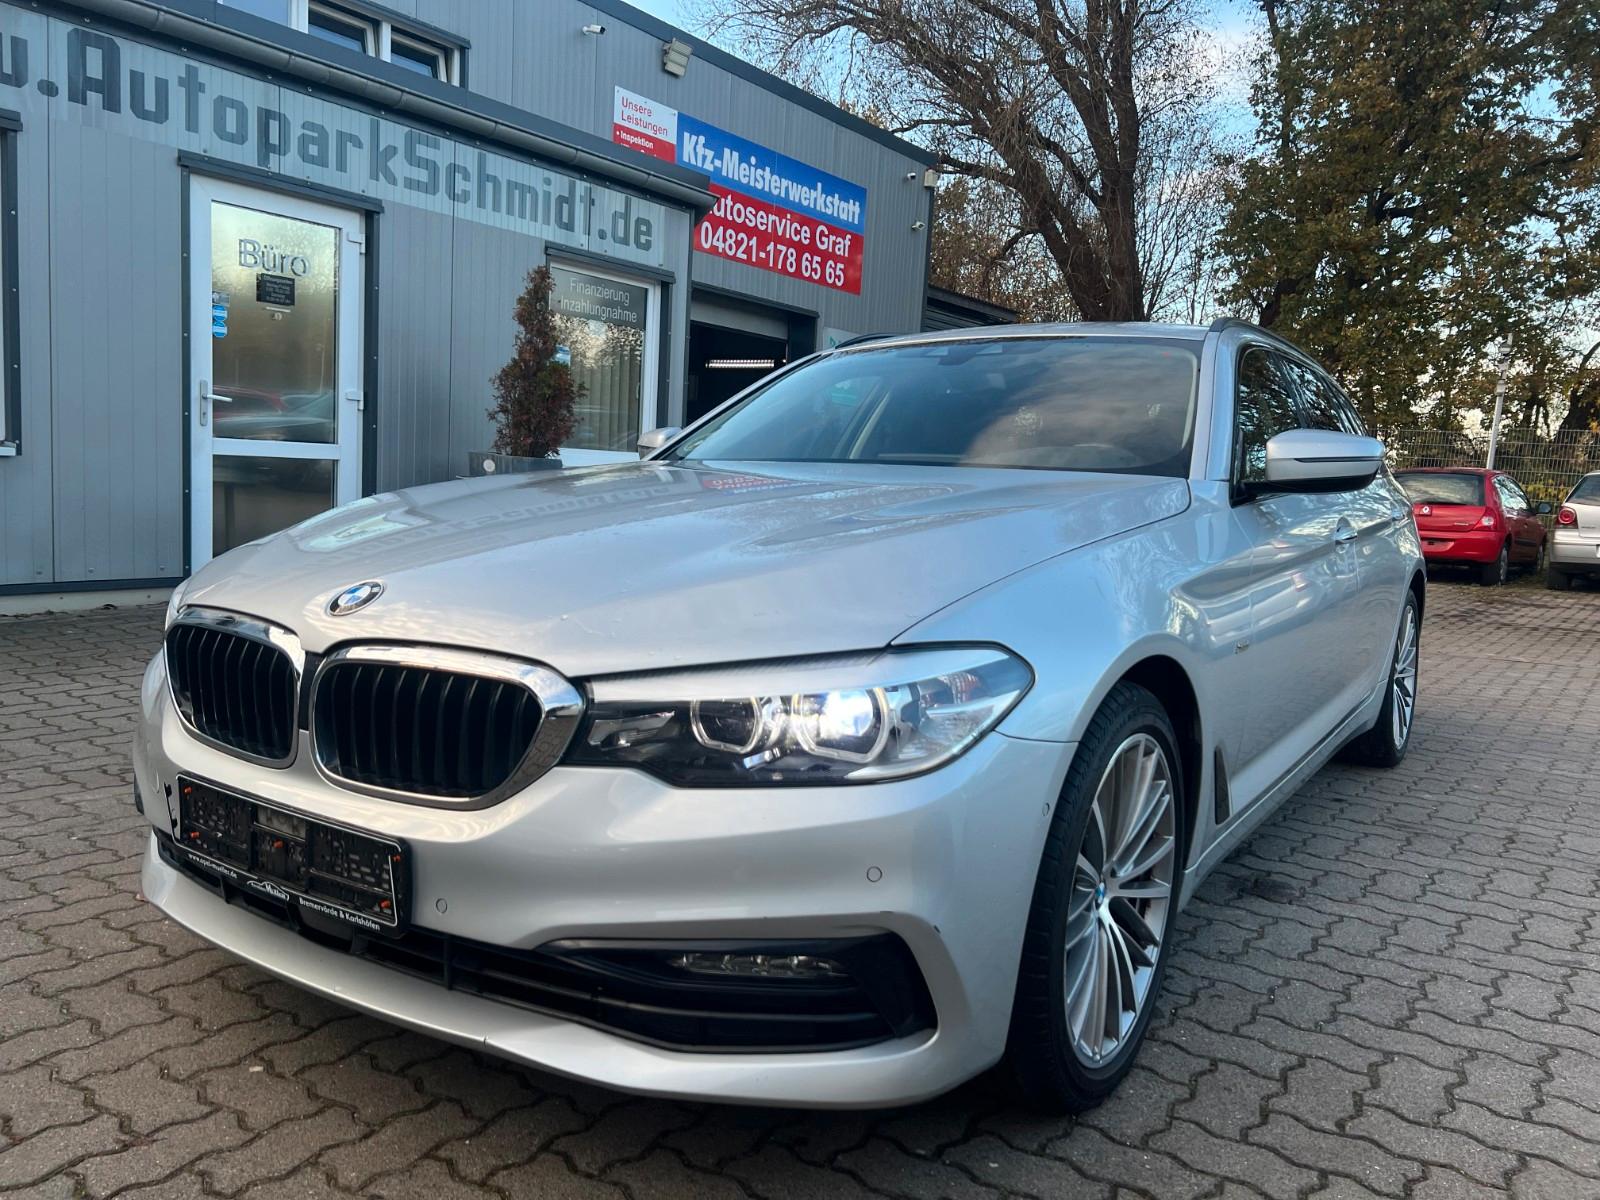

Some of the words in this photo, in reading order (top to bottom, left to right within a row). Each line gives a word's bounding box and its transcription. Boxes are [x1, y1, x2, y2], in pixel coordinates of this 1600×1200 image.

[621, 96, 653, 117] Unsere
[621, 110, 668, 136] Leistungen
[620, 130, 654, 149] Inspektion
[683, 131, 861, 225] Kfz-Meisterwerkstatt
[710, 193, 810, 244] utoservice
[815, 225, 852, 258] Graf
[238, 238, 311, 277] Büro
[700, 220, 796, 273] 04821-178
[801, 251, 821, 284] 65
[825, 258, 845, 287] 65
[570, 278, 630, 306] Finanzierung
[560, 296, 637, 322] Inzahlungnahme
